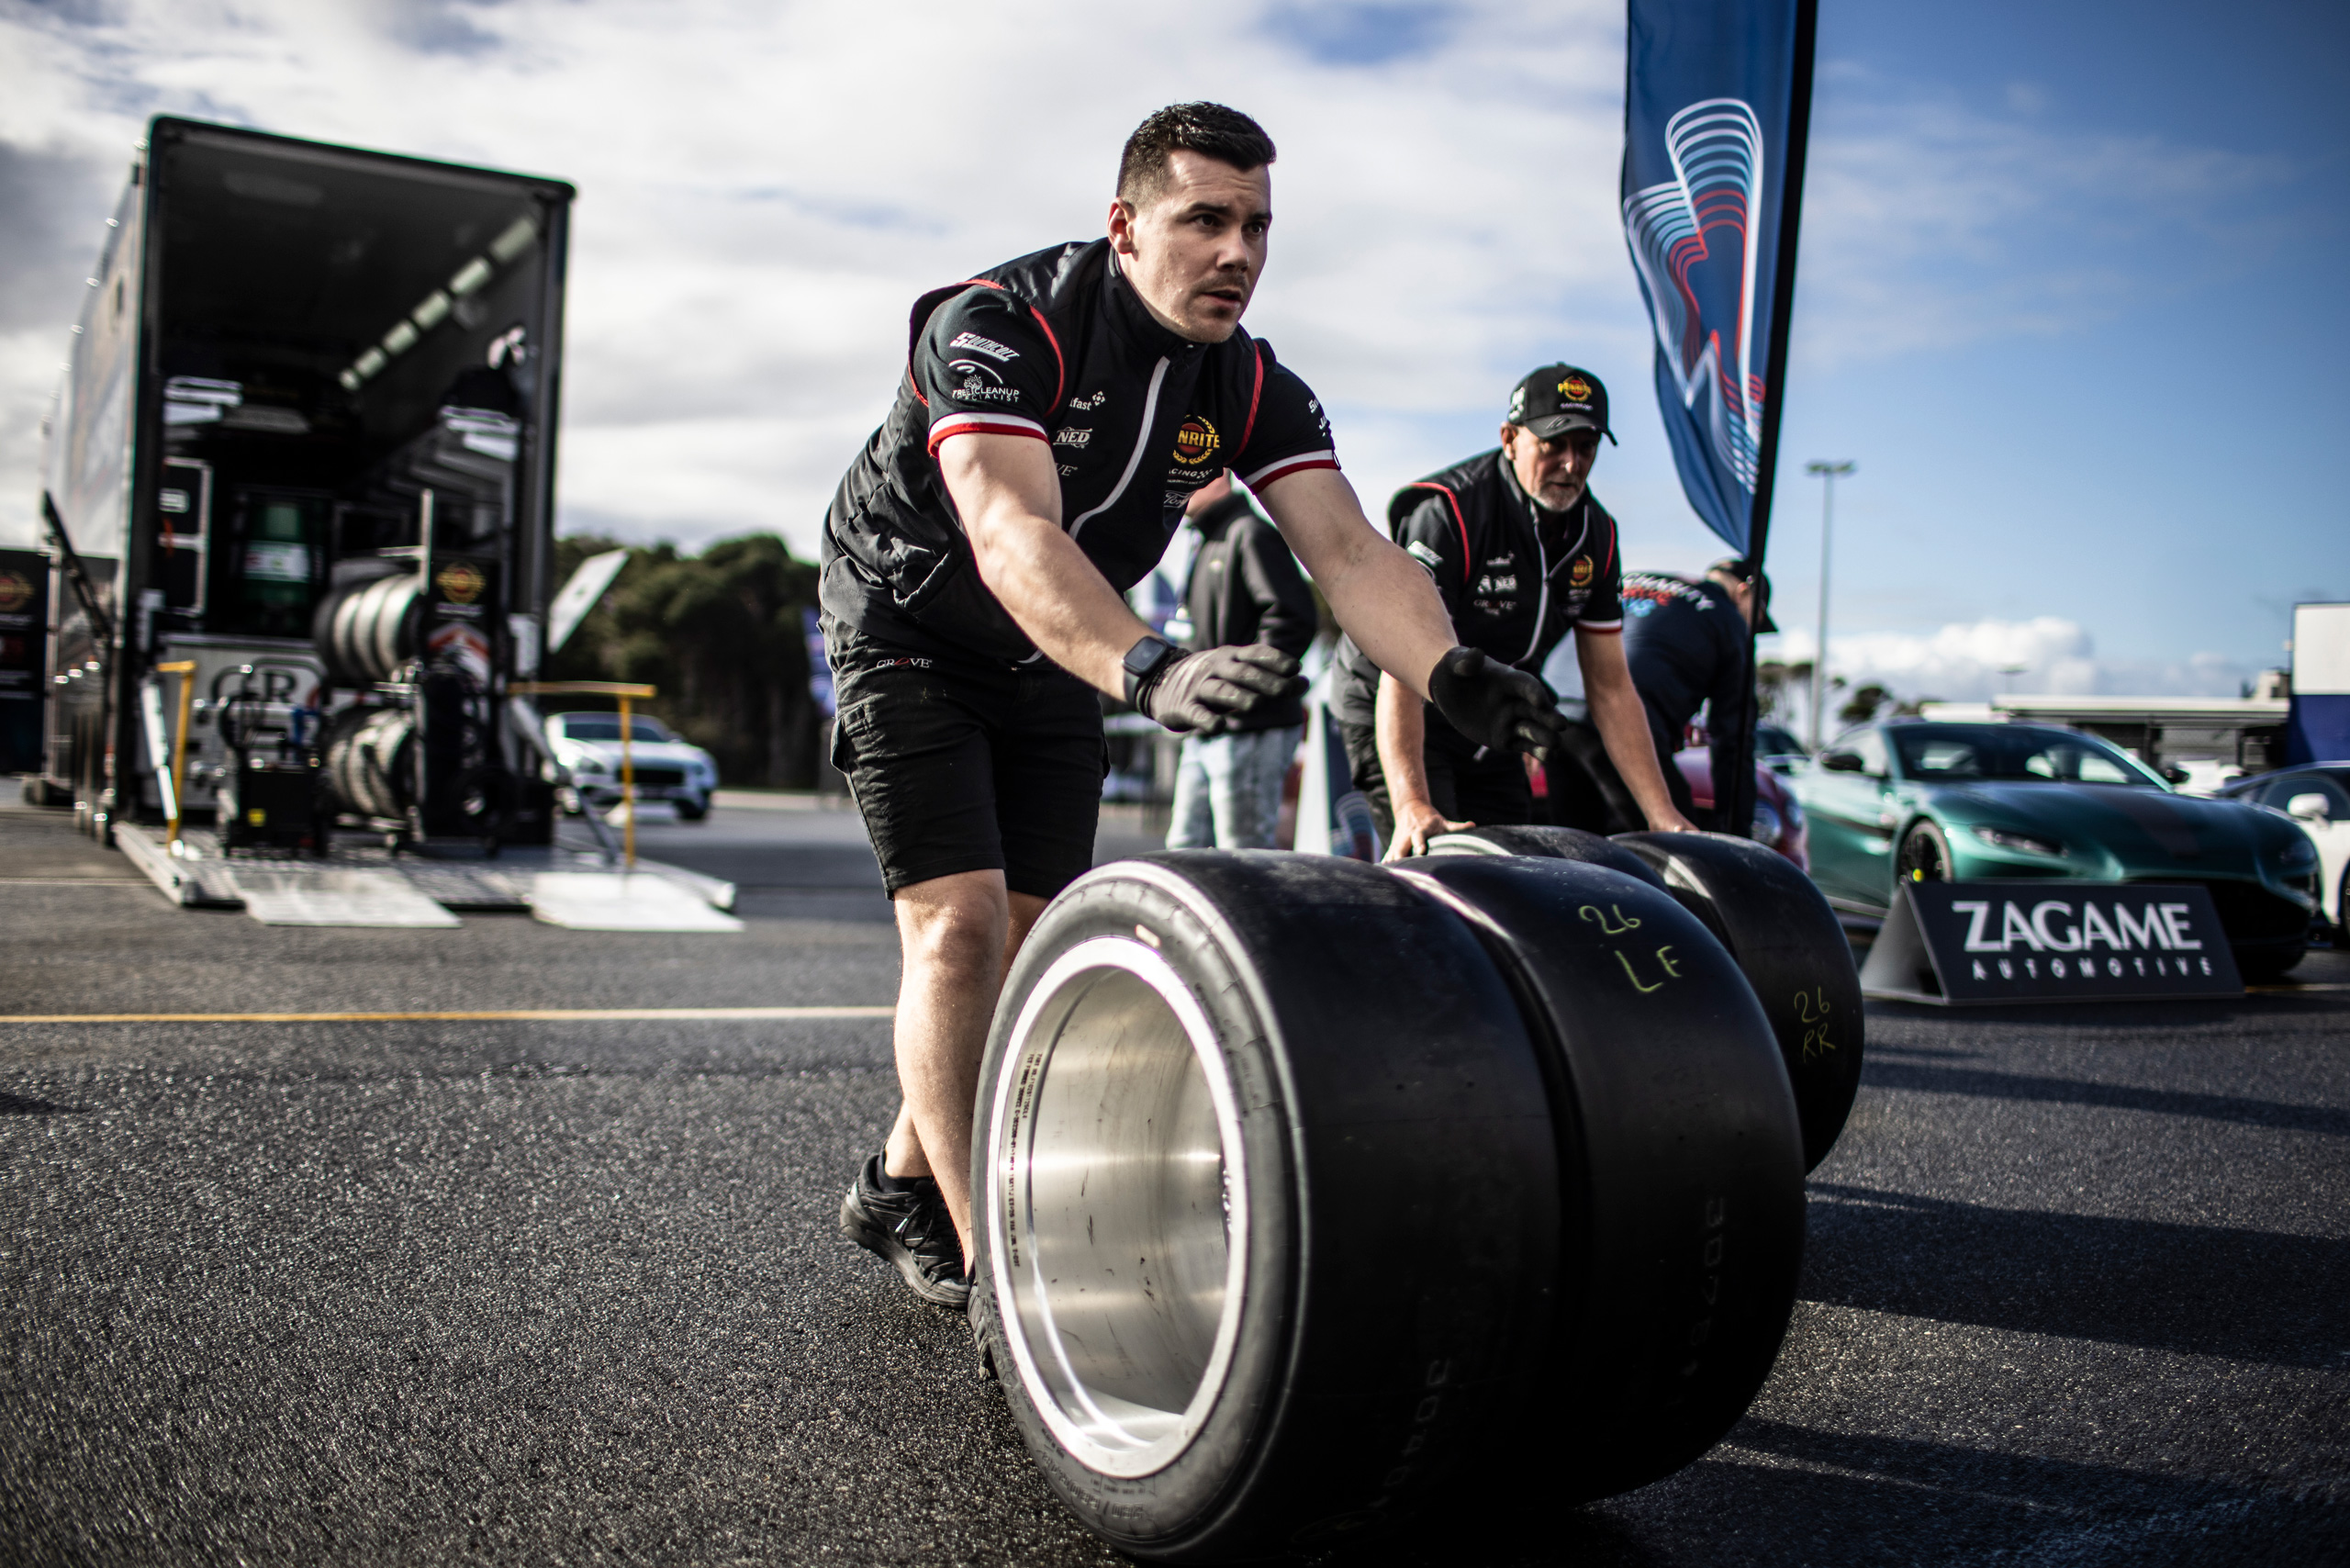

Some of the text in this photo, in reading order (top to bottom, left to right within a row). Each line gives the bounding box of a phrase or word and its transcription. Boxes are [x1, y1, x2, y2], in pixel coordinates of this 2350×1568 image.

[975, 387, 1019, 397] CLEANUP
[1056, 431, 1091, 443] NED
[1579, 904, 1641, 934] 26
[1952, 901, 2202, 952] ZAGAME
[1615, 946, 1682, 992] LF
[1973, 957, 2211, 980] AUTOMOTIVE
[1794, 985, 1830, 1024] 26
[1803, 1022, 1836, 1063] RR
